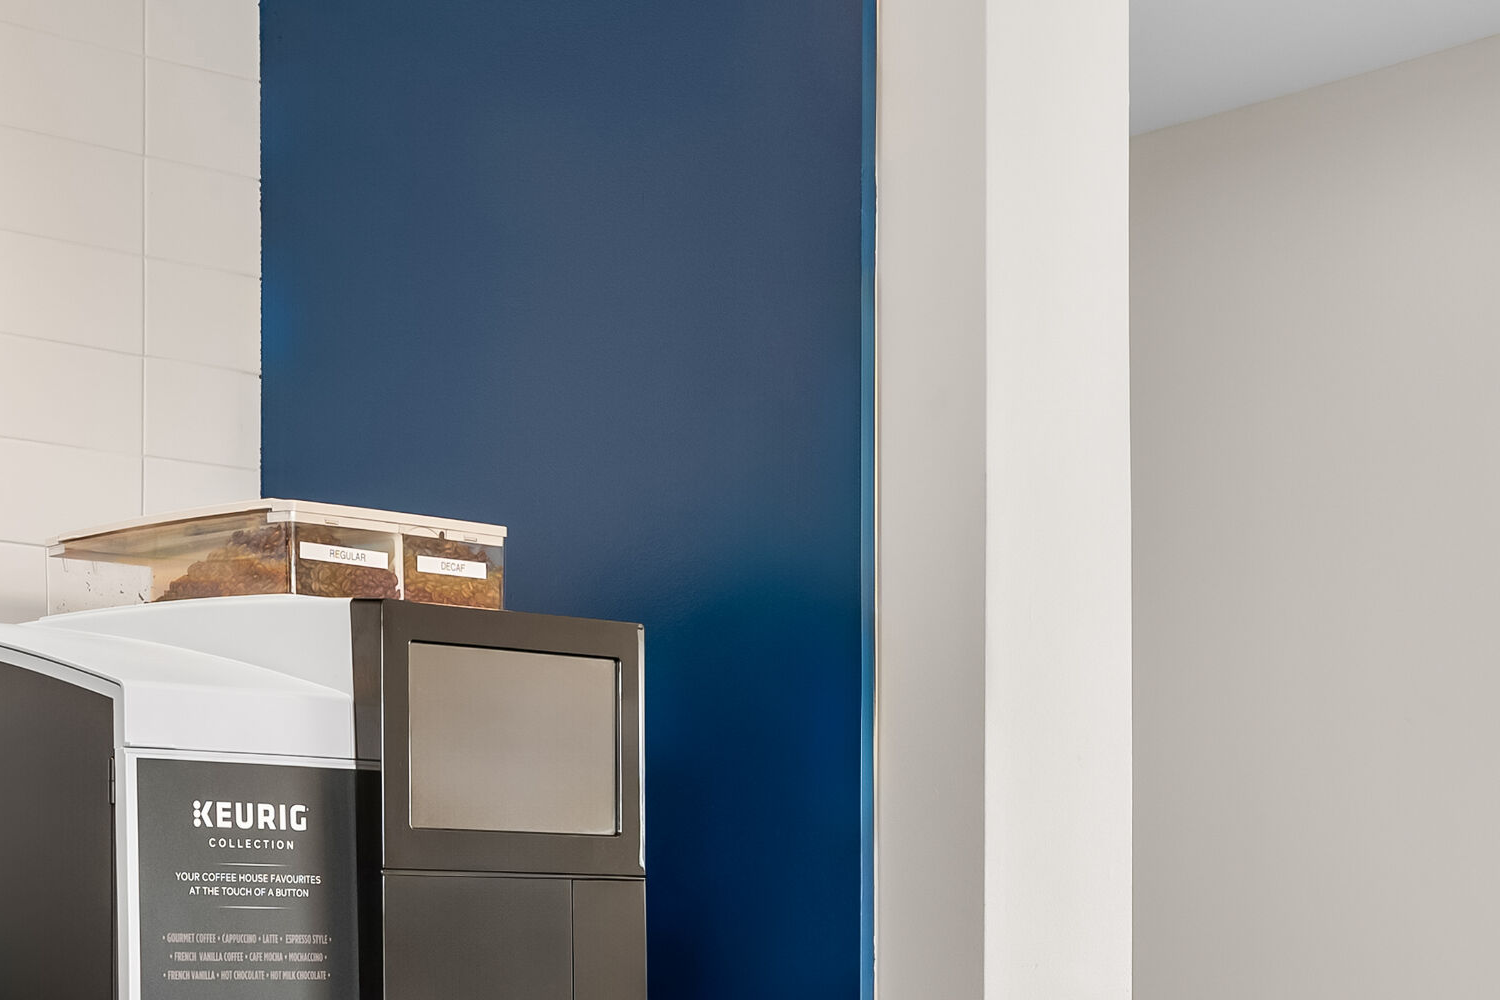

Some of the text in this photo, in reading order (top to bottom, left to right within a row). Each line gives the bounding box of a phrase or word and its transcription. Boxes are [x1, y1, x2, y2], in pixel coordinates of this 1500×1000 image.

[329, 549, 366, 562] REGULAR
[440, 561, 466, 573] DECAF
[192, 799, 308, 832] KEURIG
[208, 837, 295, 850] COLLECTION
[175, 871, 322, 885] YOUR COFFEE HOUSE FAVOURITES
[188, 886, 310, 898] AT THE TOUCH OF A BUTTON
[166, 932, 328, 945] GOURMET COFFEE CAPPUCCINO LATTE ESPRESSO STYLE
[174, 951, 197, 962] FRENCH
[198, 951, 223, 962] VANILLA
[223, 951, 244, 962] COFFEE
[263, 951, 283, 962] MOCHA
[167, 970, 327, 980] FRENCH VANILLA HOT CHOCOLATE HOT MILK CHOCOLATE
